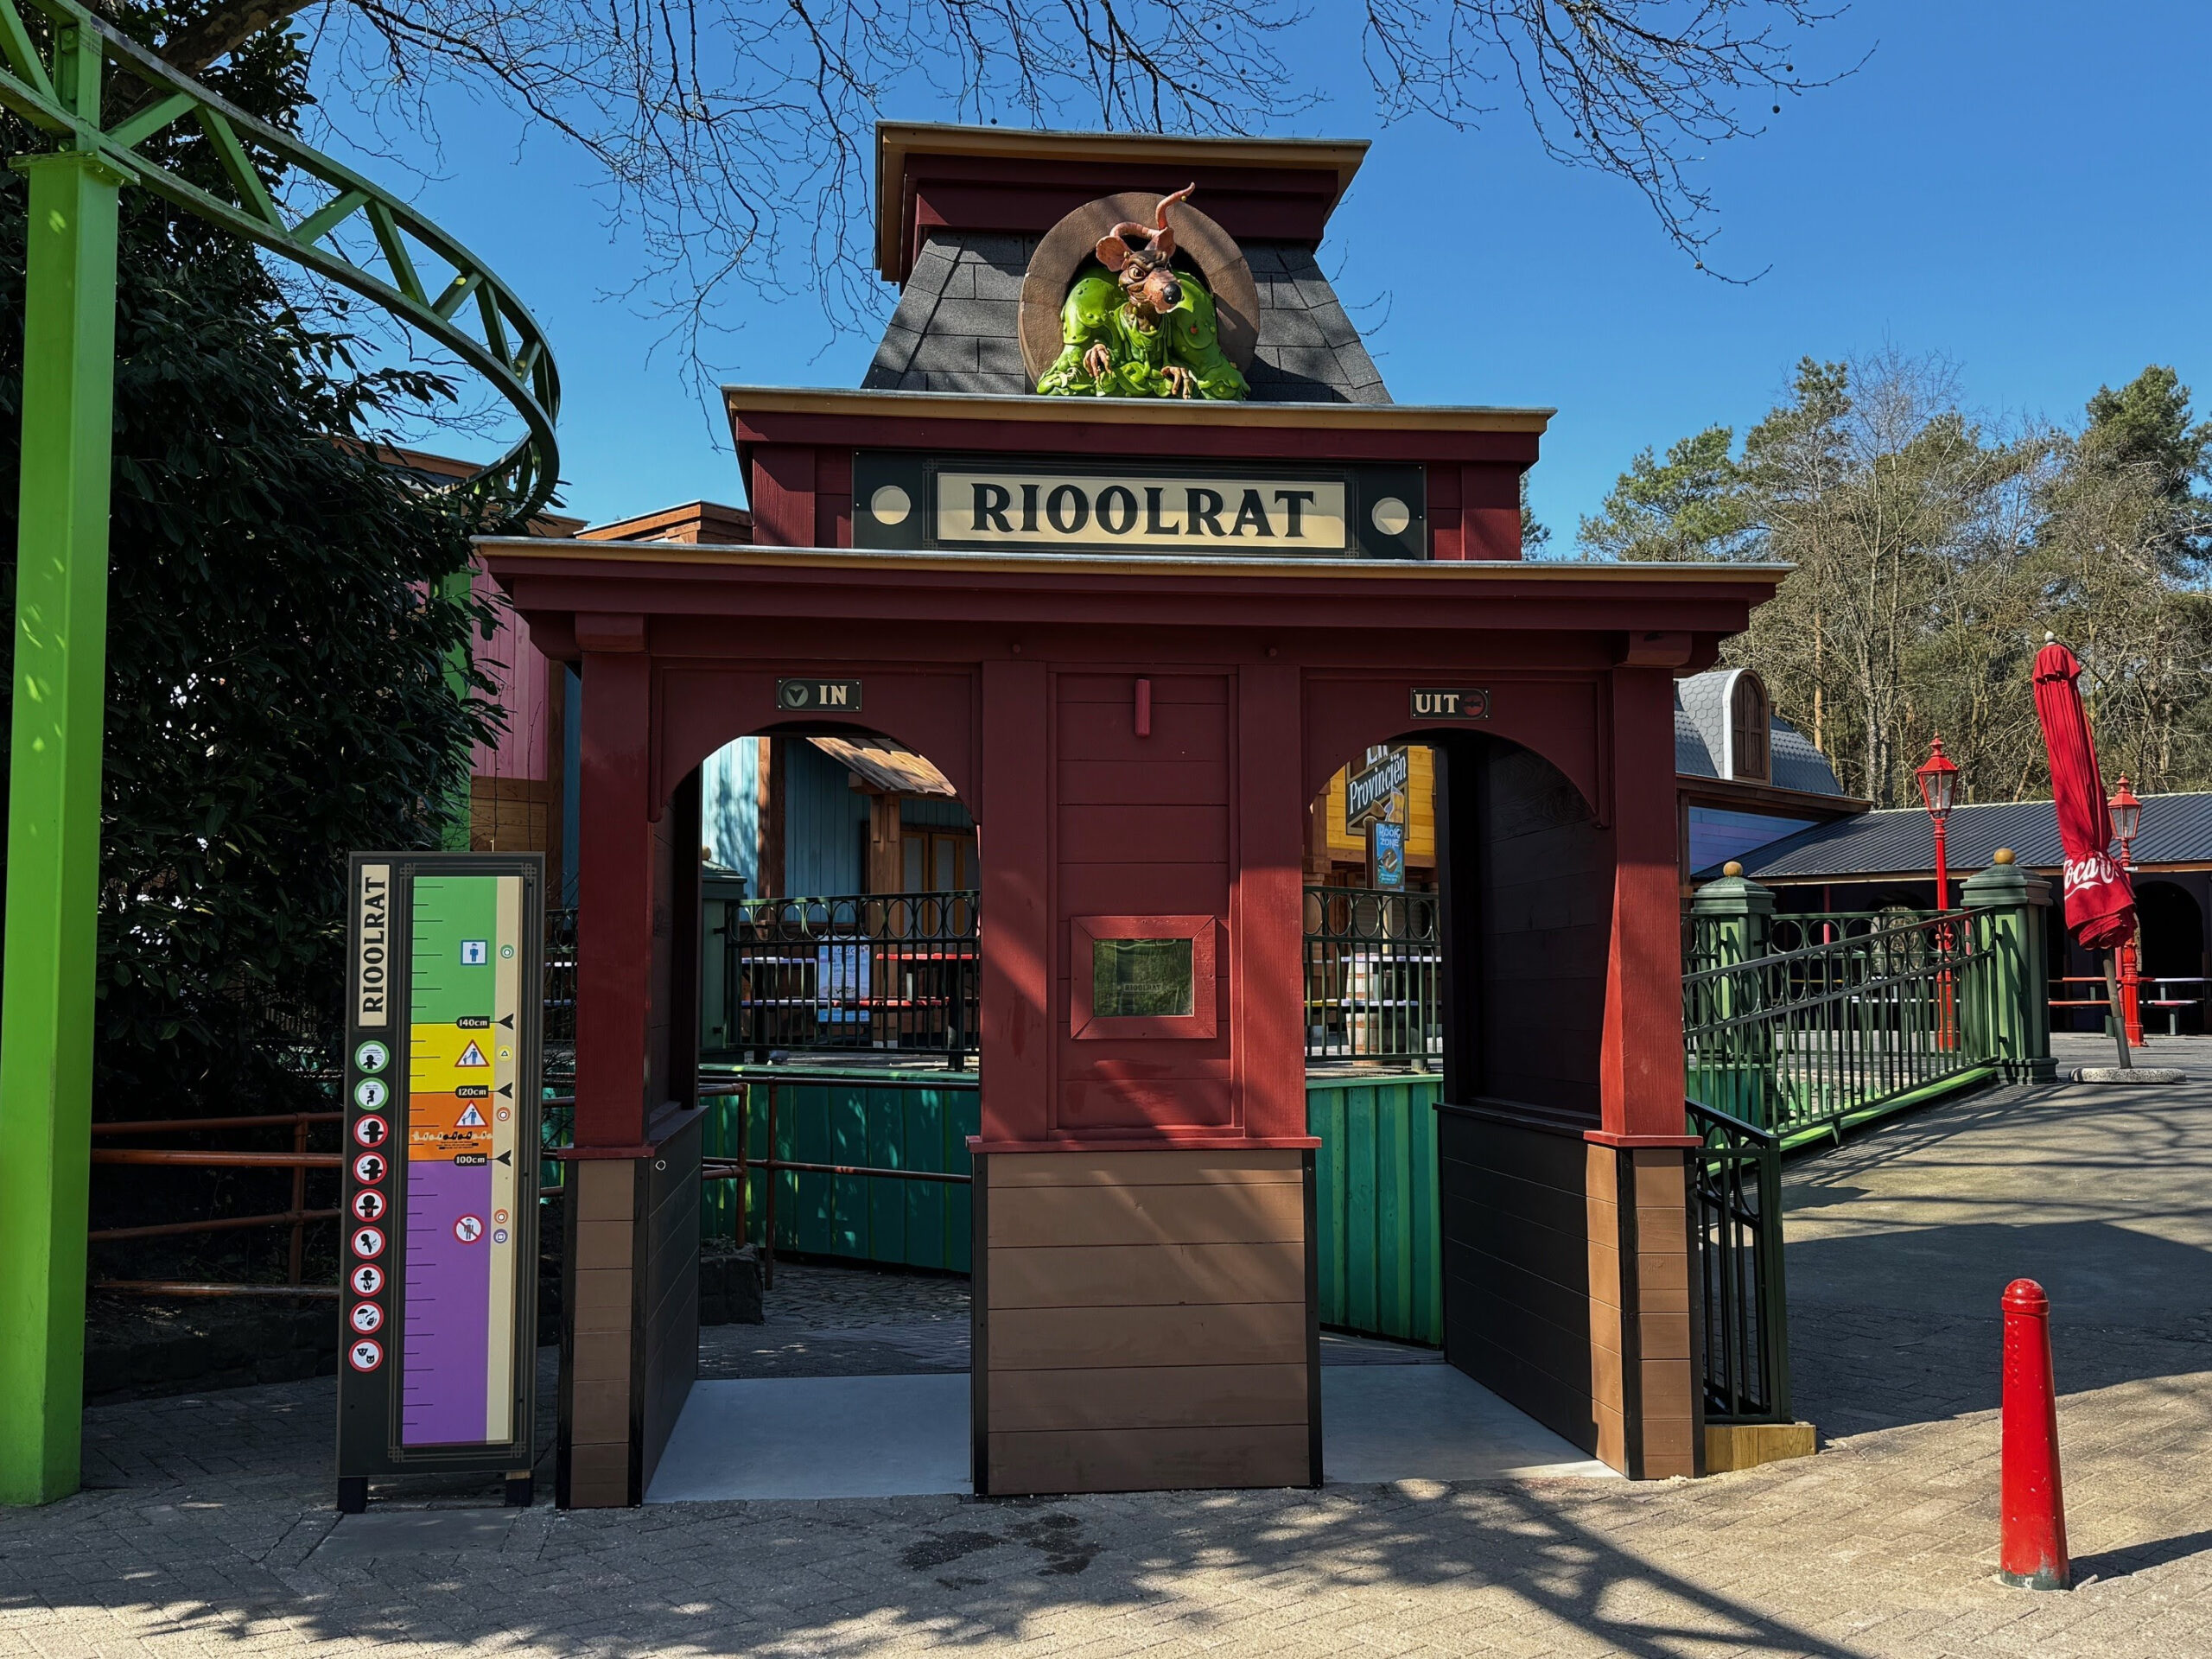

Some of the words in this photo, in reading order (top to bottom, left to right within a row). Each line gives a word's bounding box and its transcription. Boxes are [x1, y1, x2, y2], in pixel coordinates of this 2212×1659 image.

[969, 482, 1317, 538] RIOOLRAT
[819, 684, 848, 705] IN
[1414, 694, 1459, 713] UIT
[1349, 753, 1407, 816] Provinciën
[363, 876, 386, 1014] RIOOLRAT
